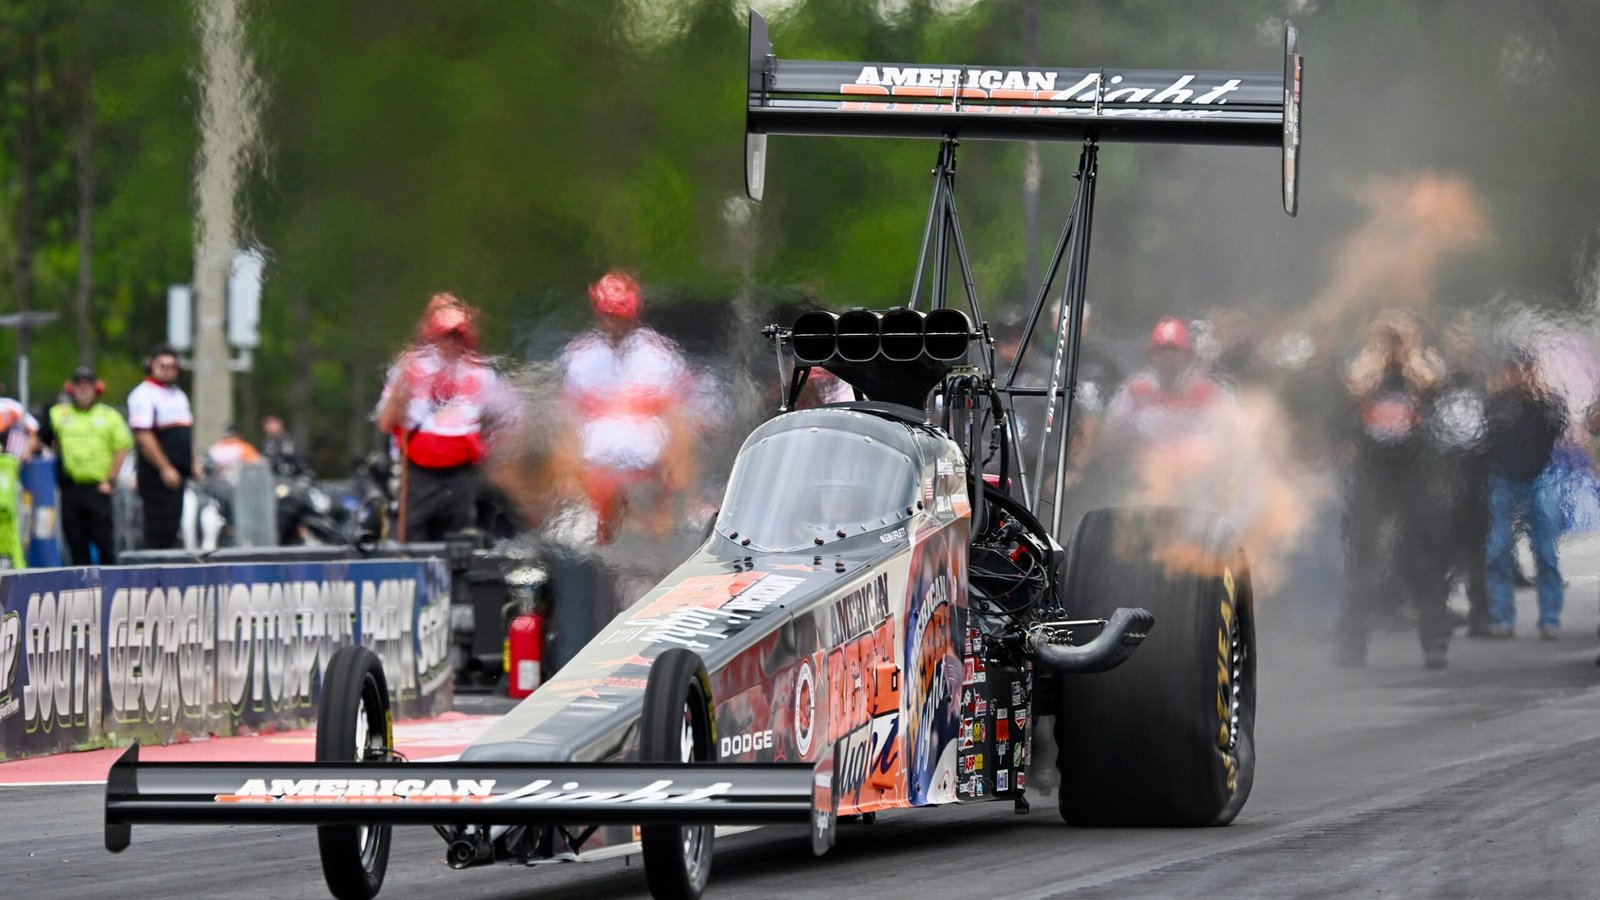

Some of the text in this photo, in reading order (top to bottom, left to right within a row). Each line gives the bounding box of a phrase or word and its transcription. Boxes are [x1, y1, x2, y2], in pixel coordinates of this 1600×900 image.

[856, 66, 1057, 91] AMERICAN
[828, 572, 890, 649] AMERICAN
[108, 585, 215, 715] GEORGIA
[721, 729, 773, 758] DODGE
[235, 778, 497, 797] AMERICAN
